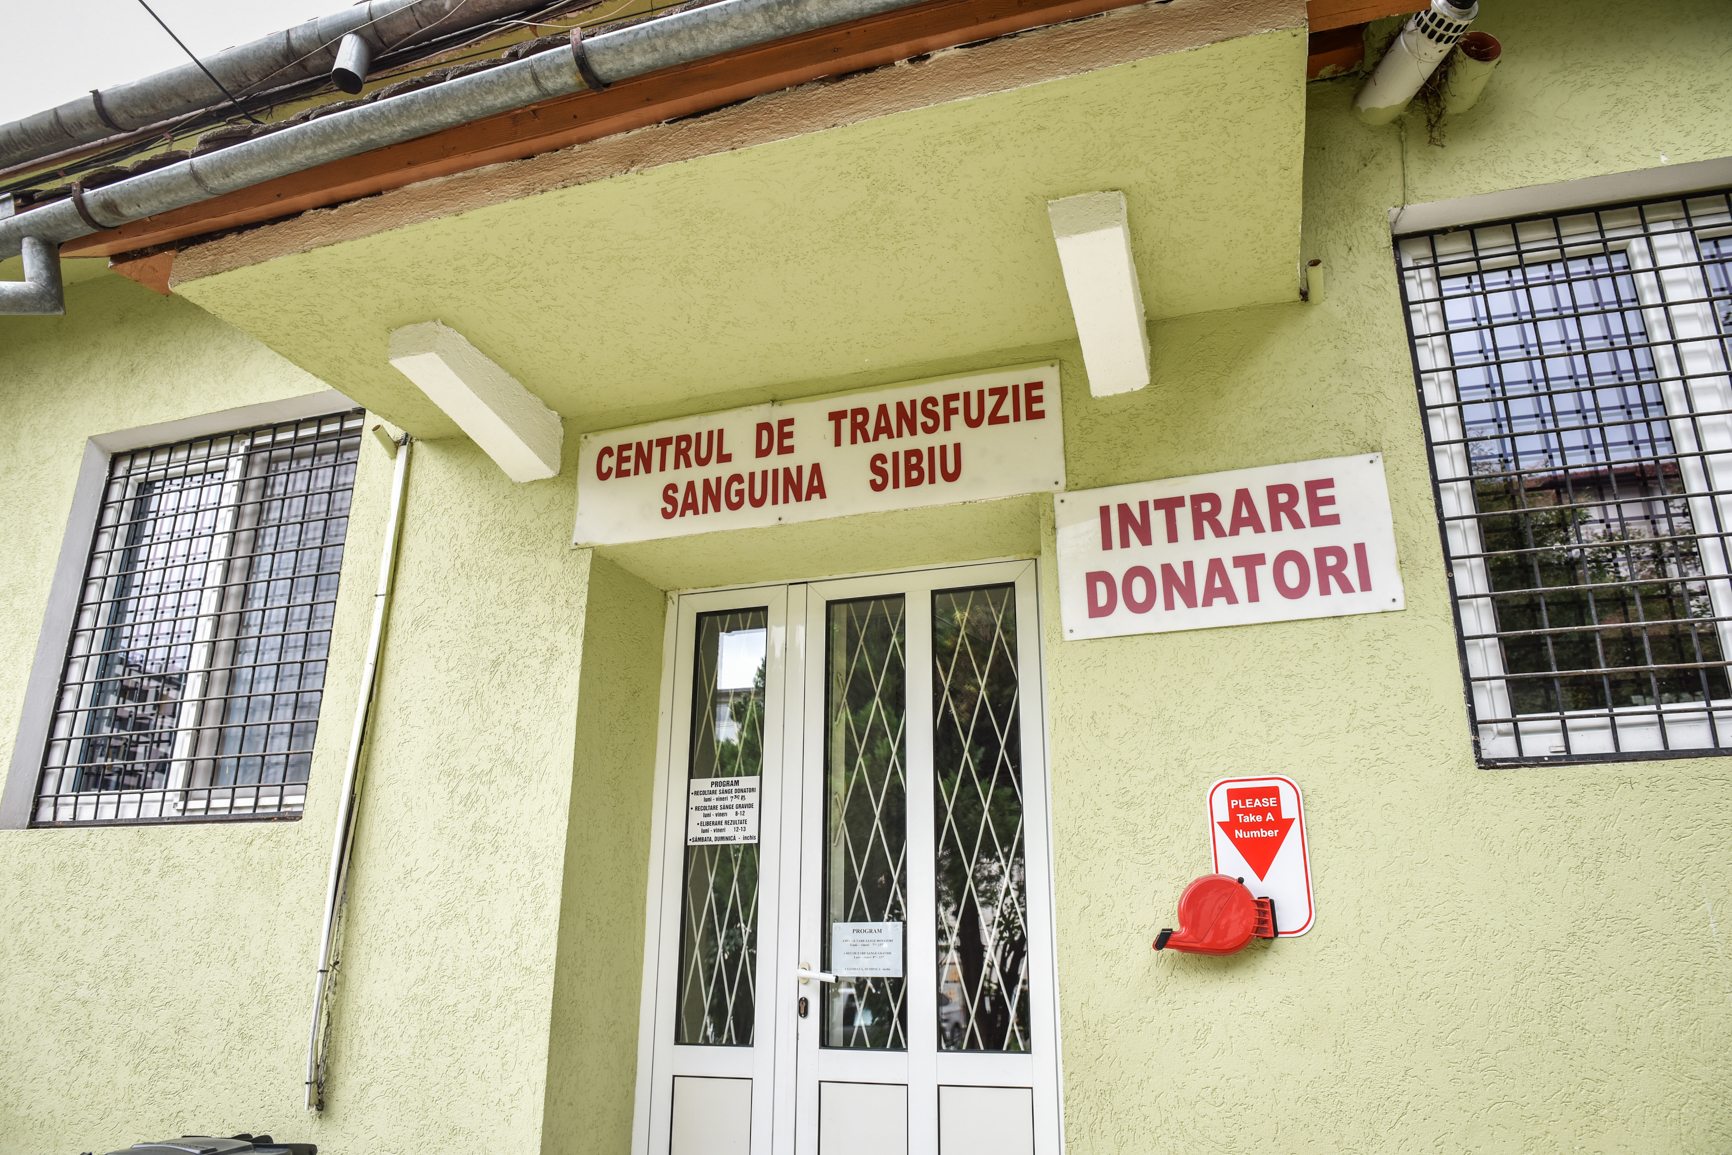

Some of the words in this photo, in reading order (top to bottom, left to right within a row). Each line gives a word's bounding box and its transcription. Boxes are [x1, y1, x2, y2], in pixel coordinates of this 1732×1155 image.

[596, 428, 732, 481] CENTRUL
[755, 418, 795, 458] DE
[828, 381, 1046, 447] TRANSFUZIE
[661, 463, 827, 519] SANGUINA
[869, 443, 962, 491] SIBIU
[1099, 477, 1341, 551] INTRARE
[1085, 542, 1372, 619] DONATORI
[710, 780, 740, 788] PROGRAM
[1231, 797, 1278, 809] PLEASE
[1234, 828, 1279, 839] Number
[1236, 813, 1262, 823] Take
[1265, 812, 1275, 822] A
